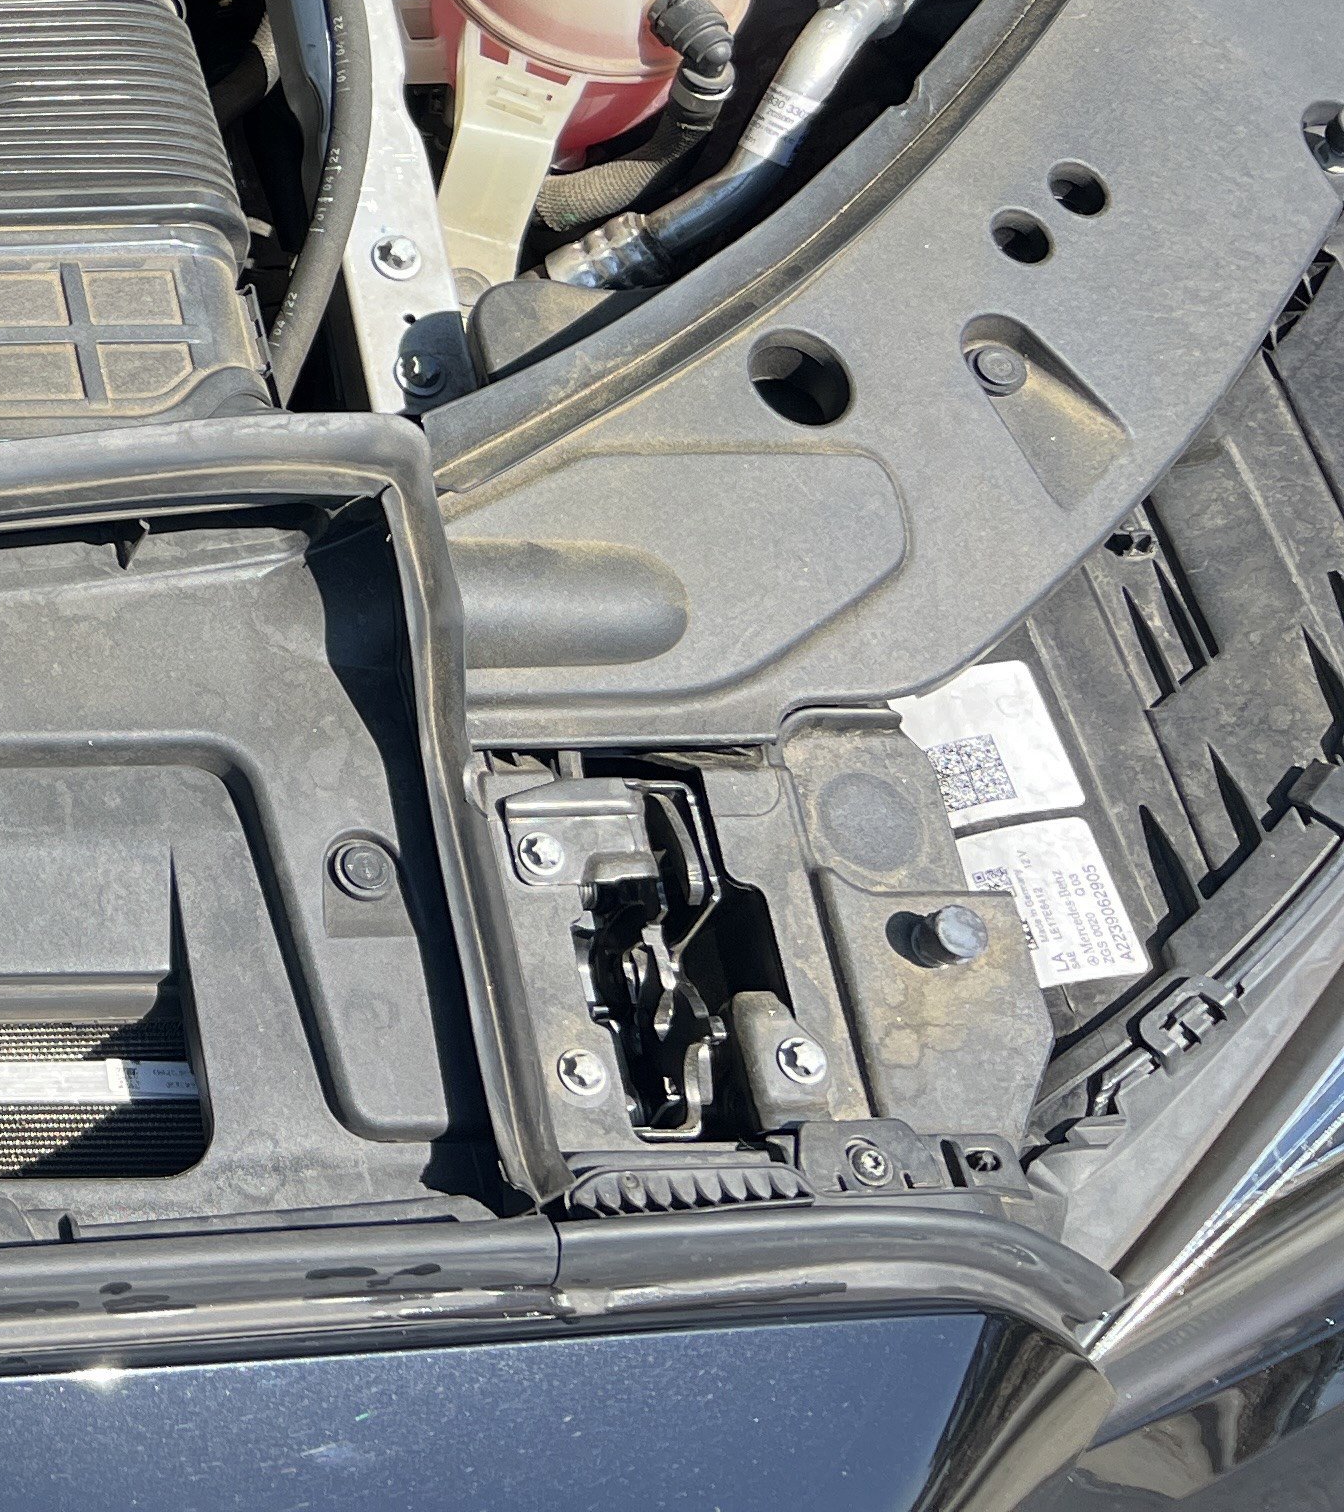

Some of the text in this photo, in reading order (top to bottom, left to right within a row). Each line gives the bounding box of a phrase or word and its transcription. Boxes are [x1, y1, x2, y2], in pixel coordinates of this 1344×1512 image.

[1051, 871, 1095, 954] Mercedes-Benz
[1081, 864, 1135, 962] A2239062905
[1051, 952, 1069, 973] LA
[1097, 941, 1115, 963] ZGS
